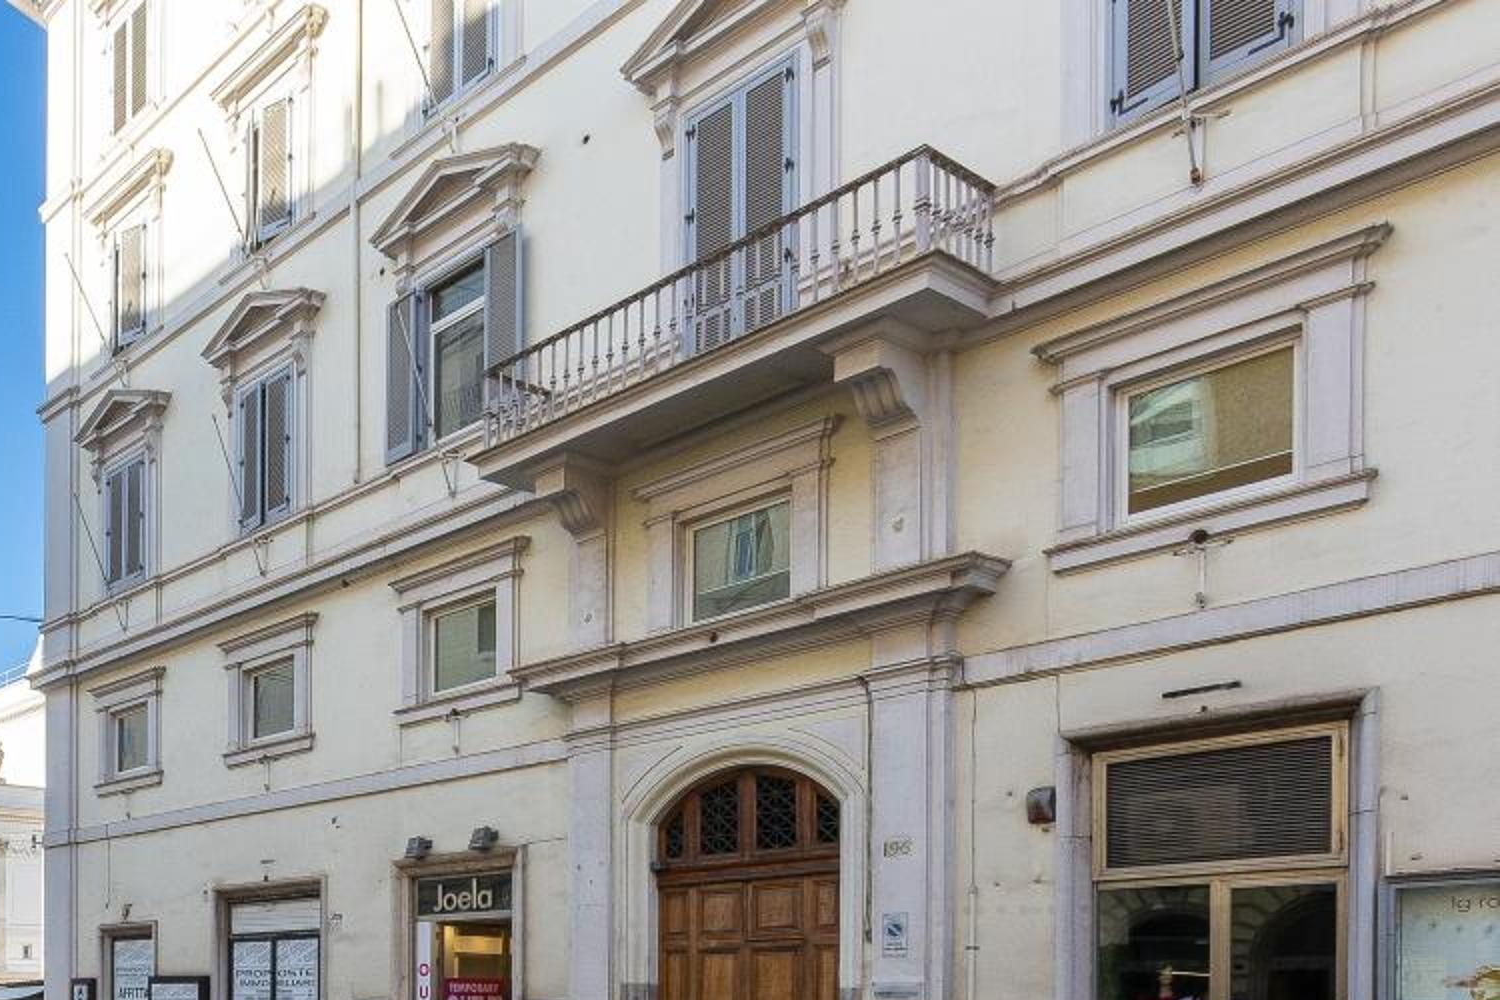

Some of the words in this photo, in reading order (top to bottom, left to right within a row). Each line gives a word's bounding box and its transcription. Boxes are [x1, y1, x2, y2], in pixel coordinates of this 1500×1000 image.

[883, 839, 912, 858] 196
[433, 877, 493, 912] Joela
[449, 982, 500, 994] TEMPORARY
